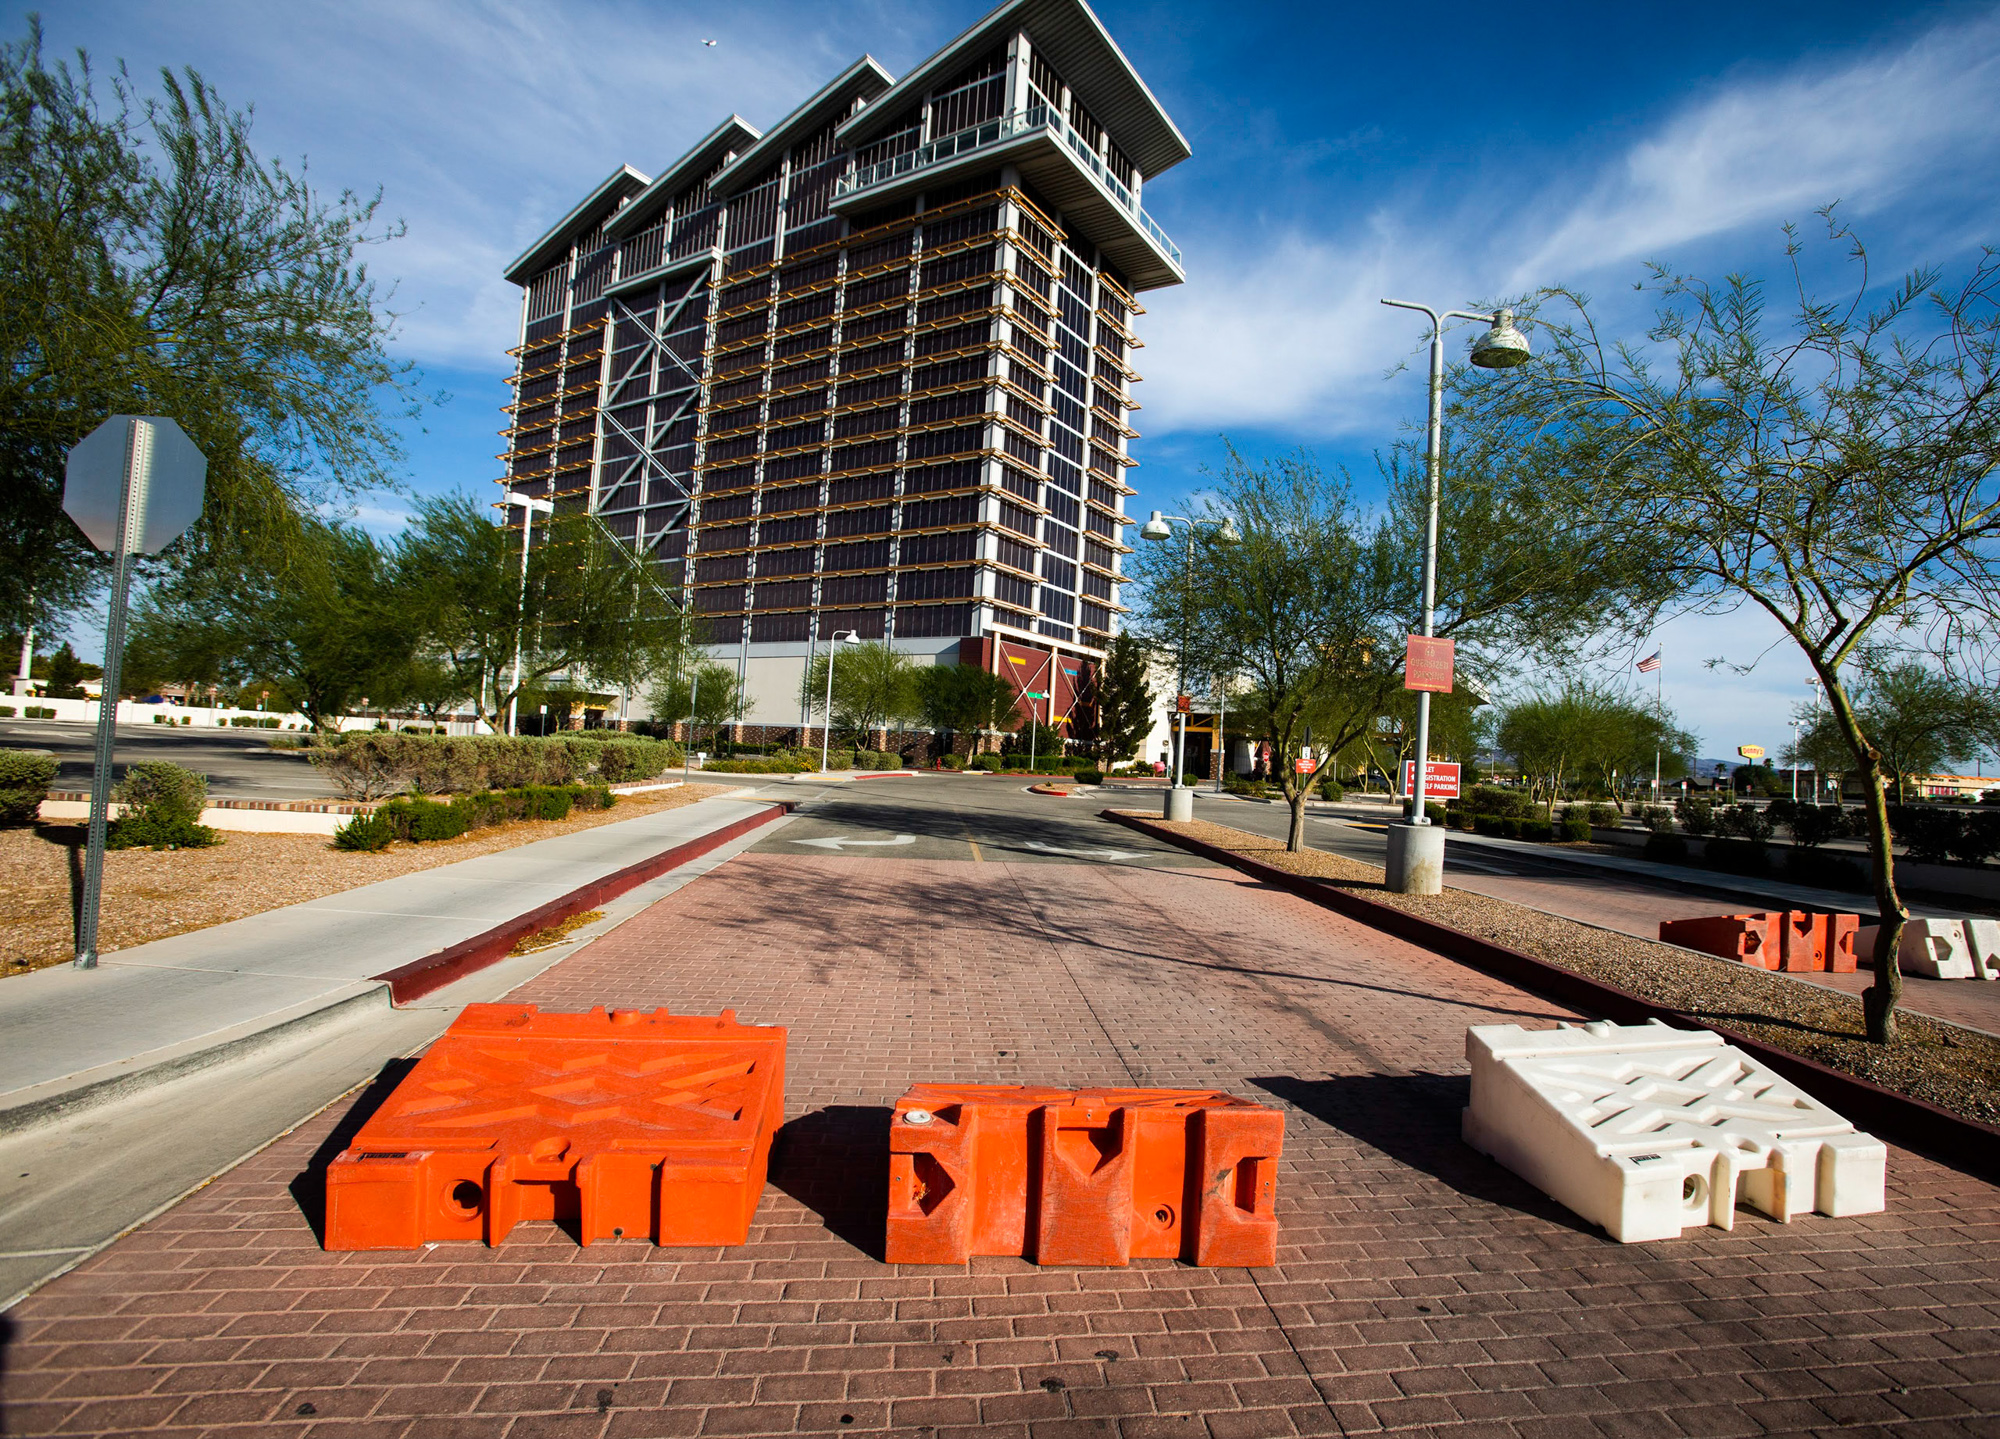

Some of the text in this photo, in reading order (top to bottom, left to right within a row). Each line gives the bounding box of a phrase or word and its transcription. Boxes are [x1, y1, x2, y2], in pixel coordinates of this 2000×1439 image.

[1411, 658, 1449, 669] OVERSIZED
[1413, 670, 1445, 681] PARKING
[1434, 783, 1457, 791] PARKING
